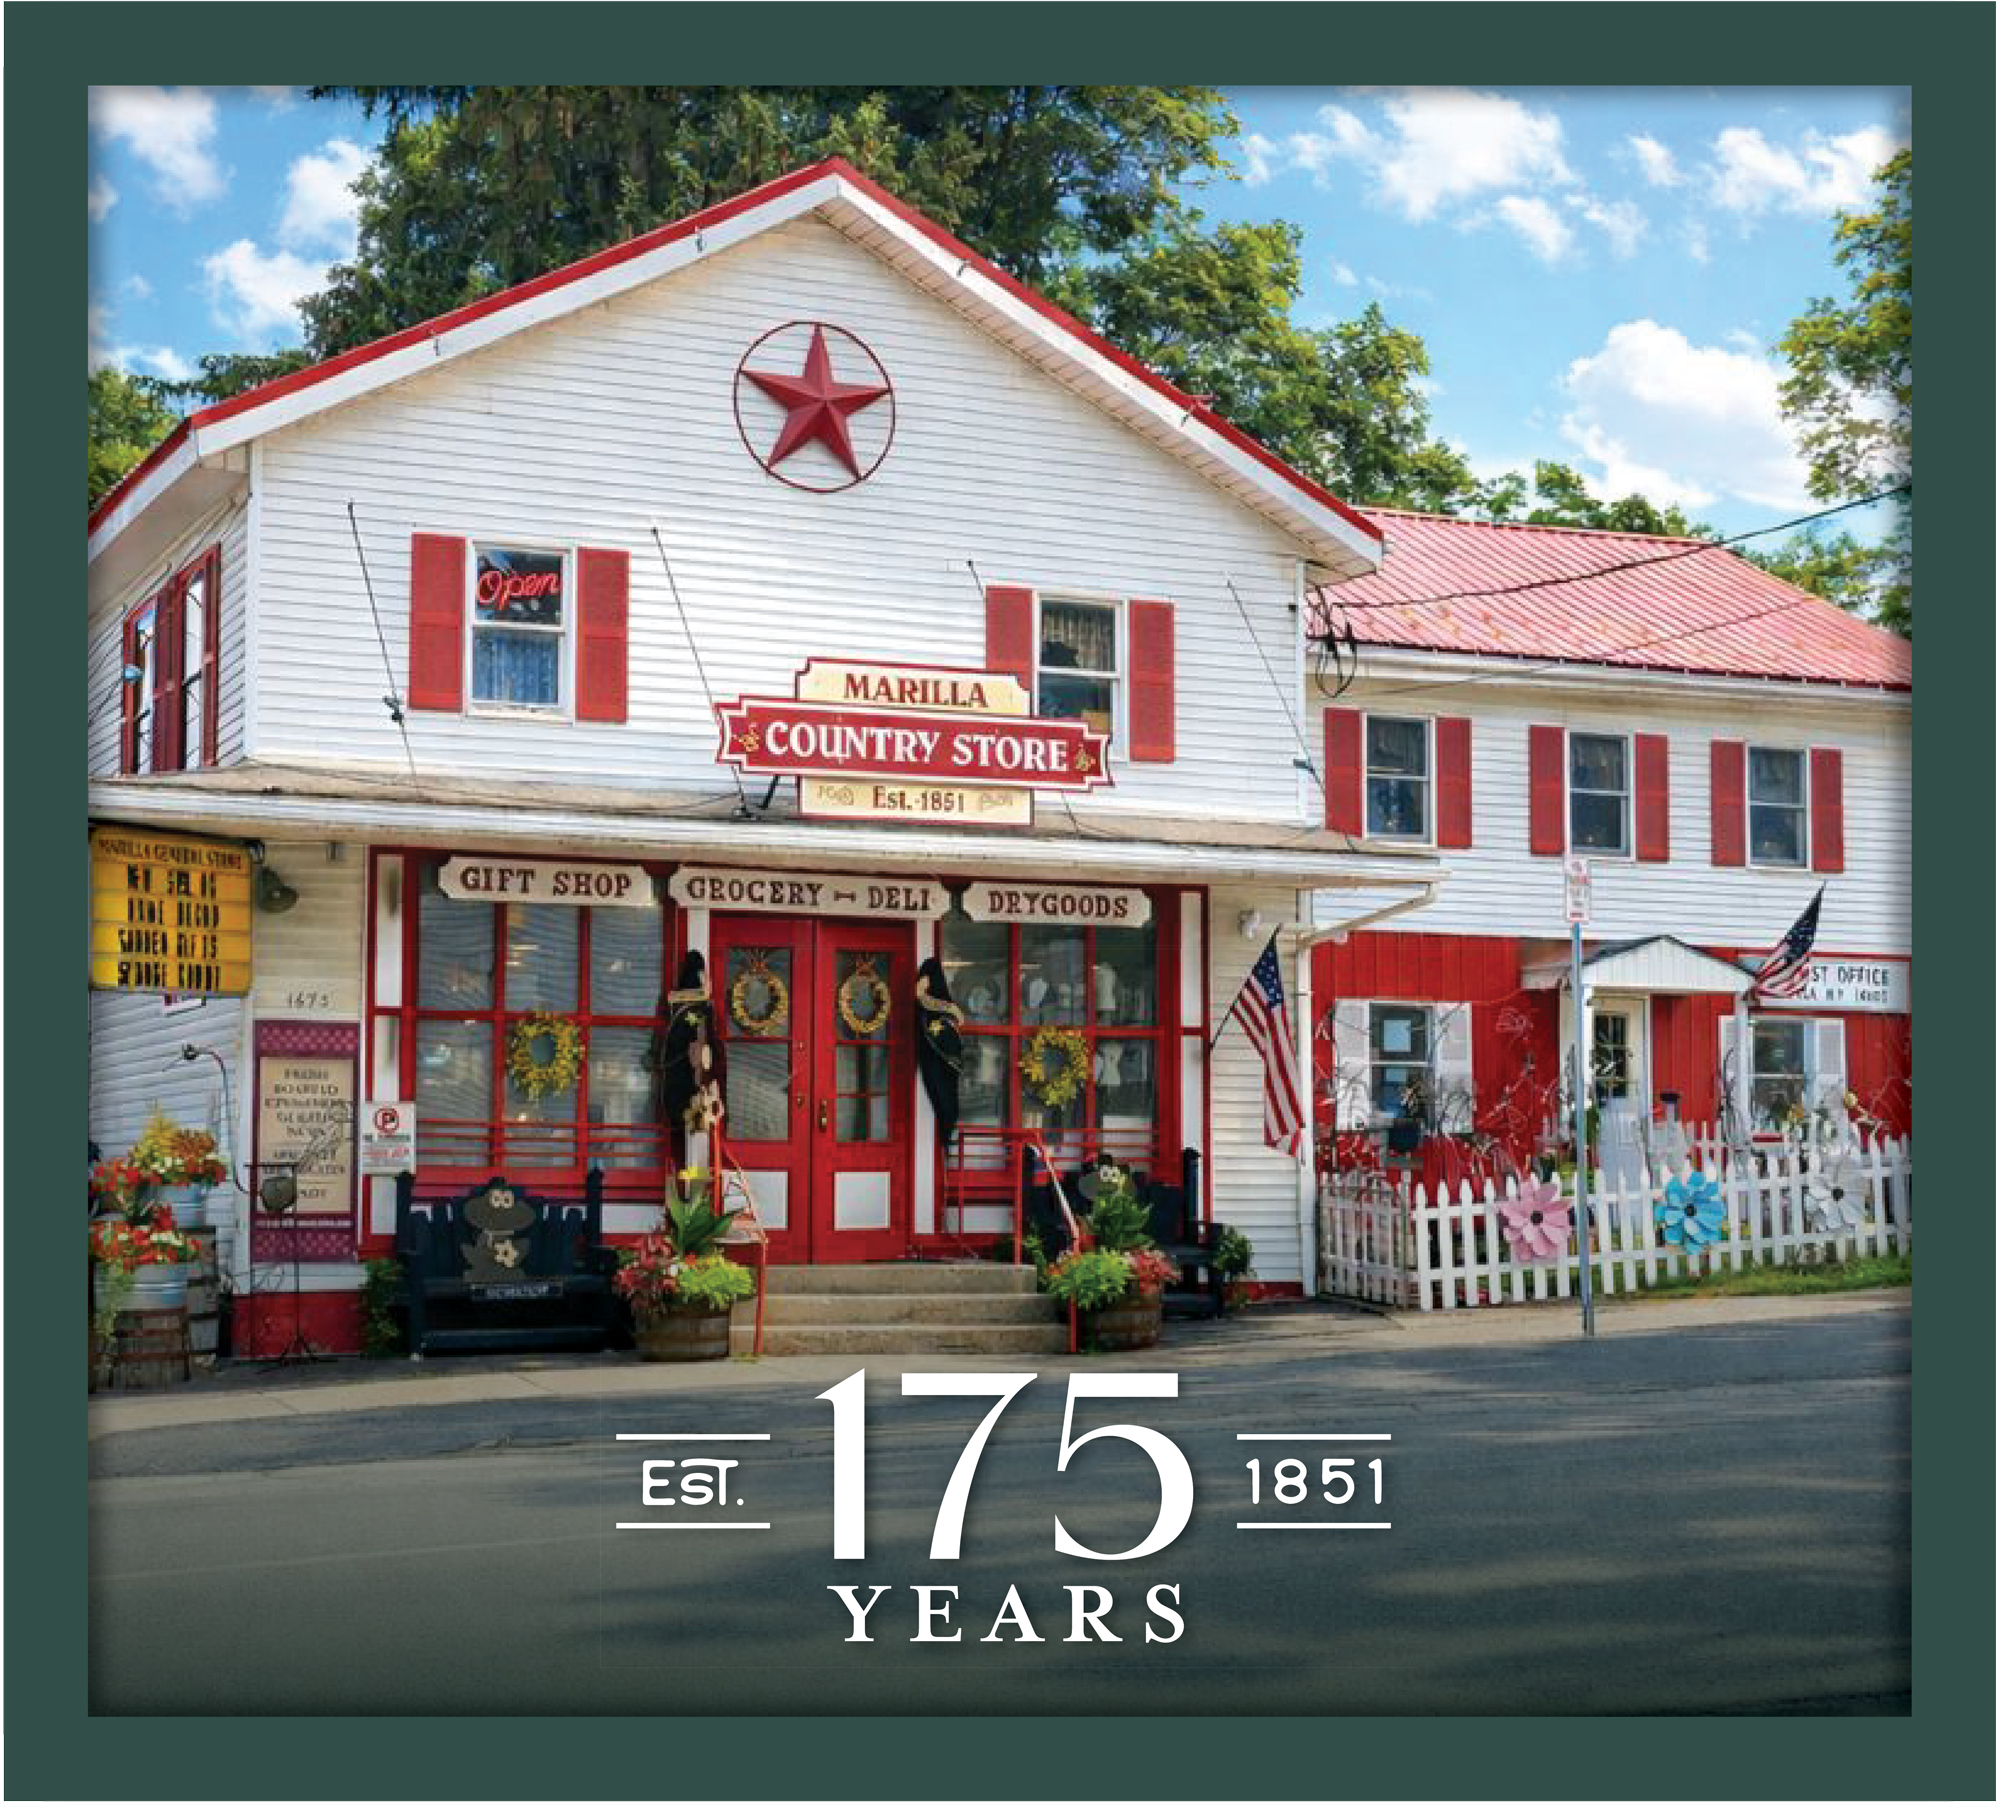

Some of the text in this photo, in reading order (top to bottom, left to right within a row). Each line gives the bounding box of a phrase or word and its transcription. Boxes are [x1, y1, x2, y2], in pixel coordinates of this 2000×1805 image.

[476, 570, 560, 611] Open
[844, 673, 989, 708] MARILLA
[765, 720, 1068, 772] COUNTRY STORE
[460, 866, 632, 899] GIFT SHOP
[687, 876, 931, 911] GROCERY DELI
[988, 890, 1129, 918] DRYGOODS
[1837, 966, 1889, 987] OFFICE
